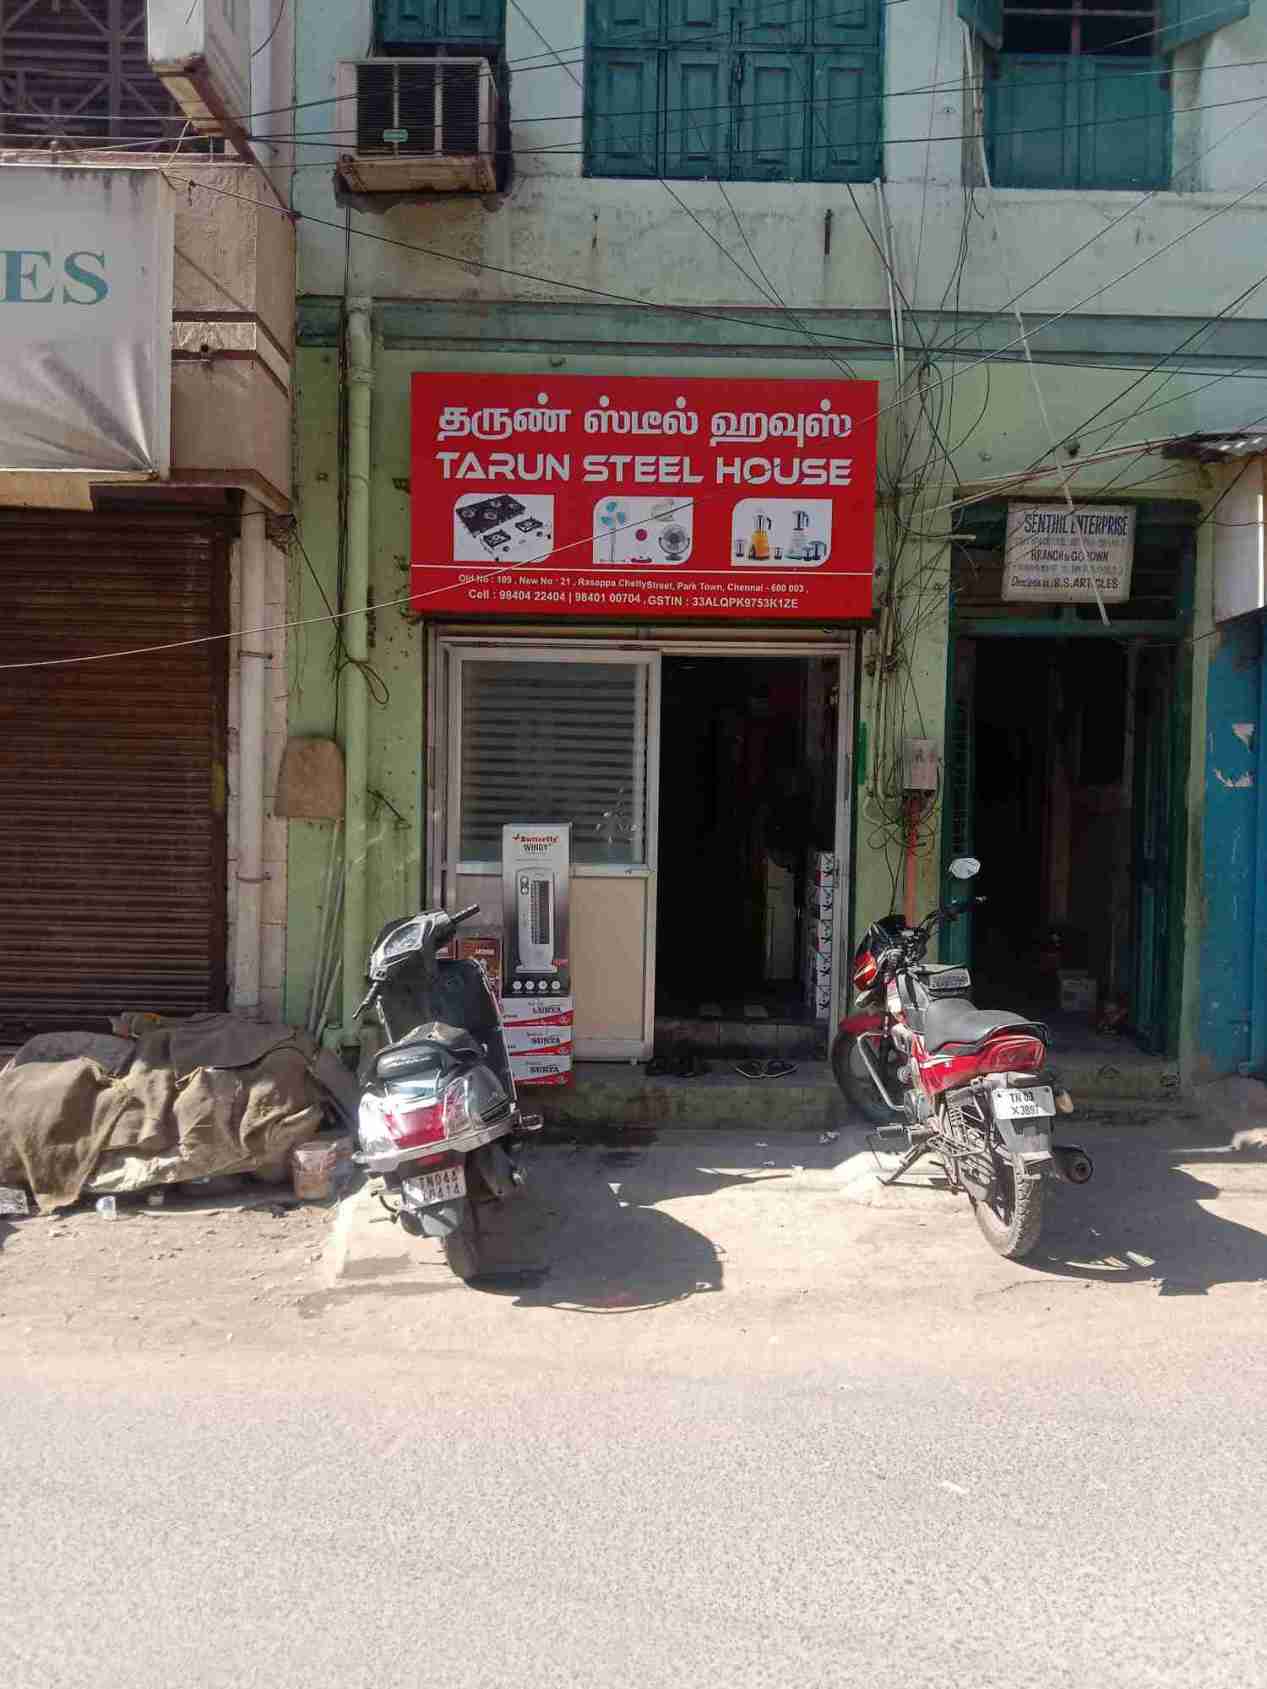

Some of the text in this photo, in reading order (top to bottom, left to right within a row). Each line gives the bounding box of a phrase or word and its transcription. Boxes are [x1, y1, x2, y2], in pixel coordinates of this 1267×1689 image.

[437, 392, 853, 448] தருண் ஸ்டீல் ஹவுஸ்
[435, 451, 853, 486] TARUN STEEL HOUSE
[727, 583, 764, 592] Chennai
